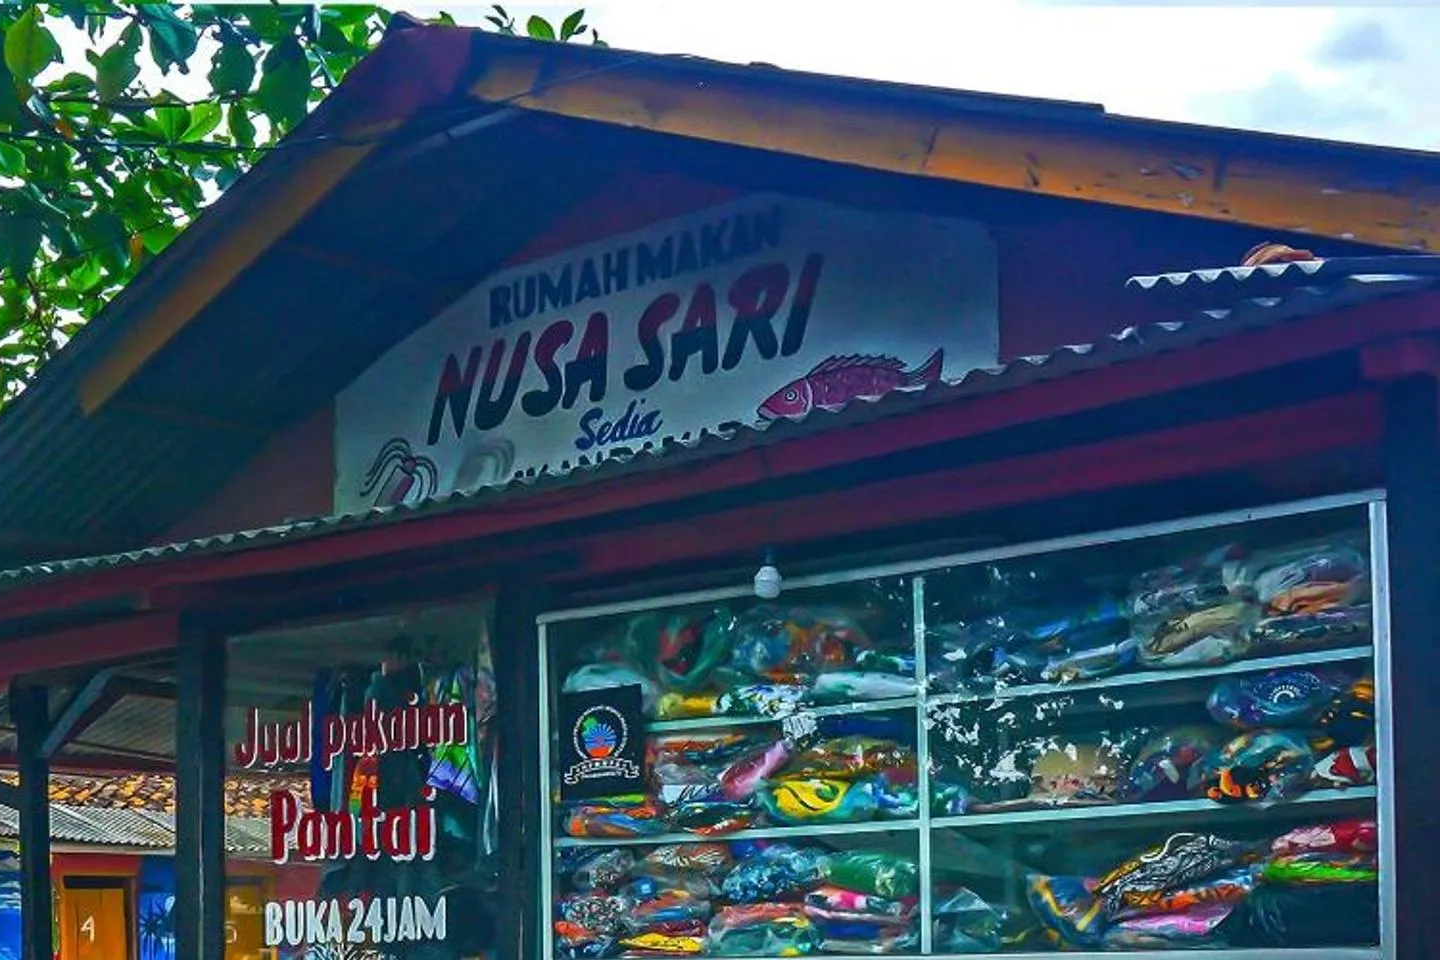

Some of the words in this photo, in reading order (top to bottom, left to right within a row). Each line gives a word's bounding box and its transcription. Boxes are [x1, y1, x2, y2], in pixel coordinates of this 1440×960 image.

[489, 251, 628, 328] RUMAH
[637, 207, 782, 285] MAKAN
[427, 311, 610, 445] NUSA
[624, 253, 824, 391] SARI
[574, 398, 663, 450] Sedia
[235, 701, 312, 768] Jual
[270, 787, 437, 865] Pantai
[81, 914, 95, 942] 4
[264, 899, 343, 946] BUKA
